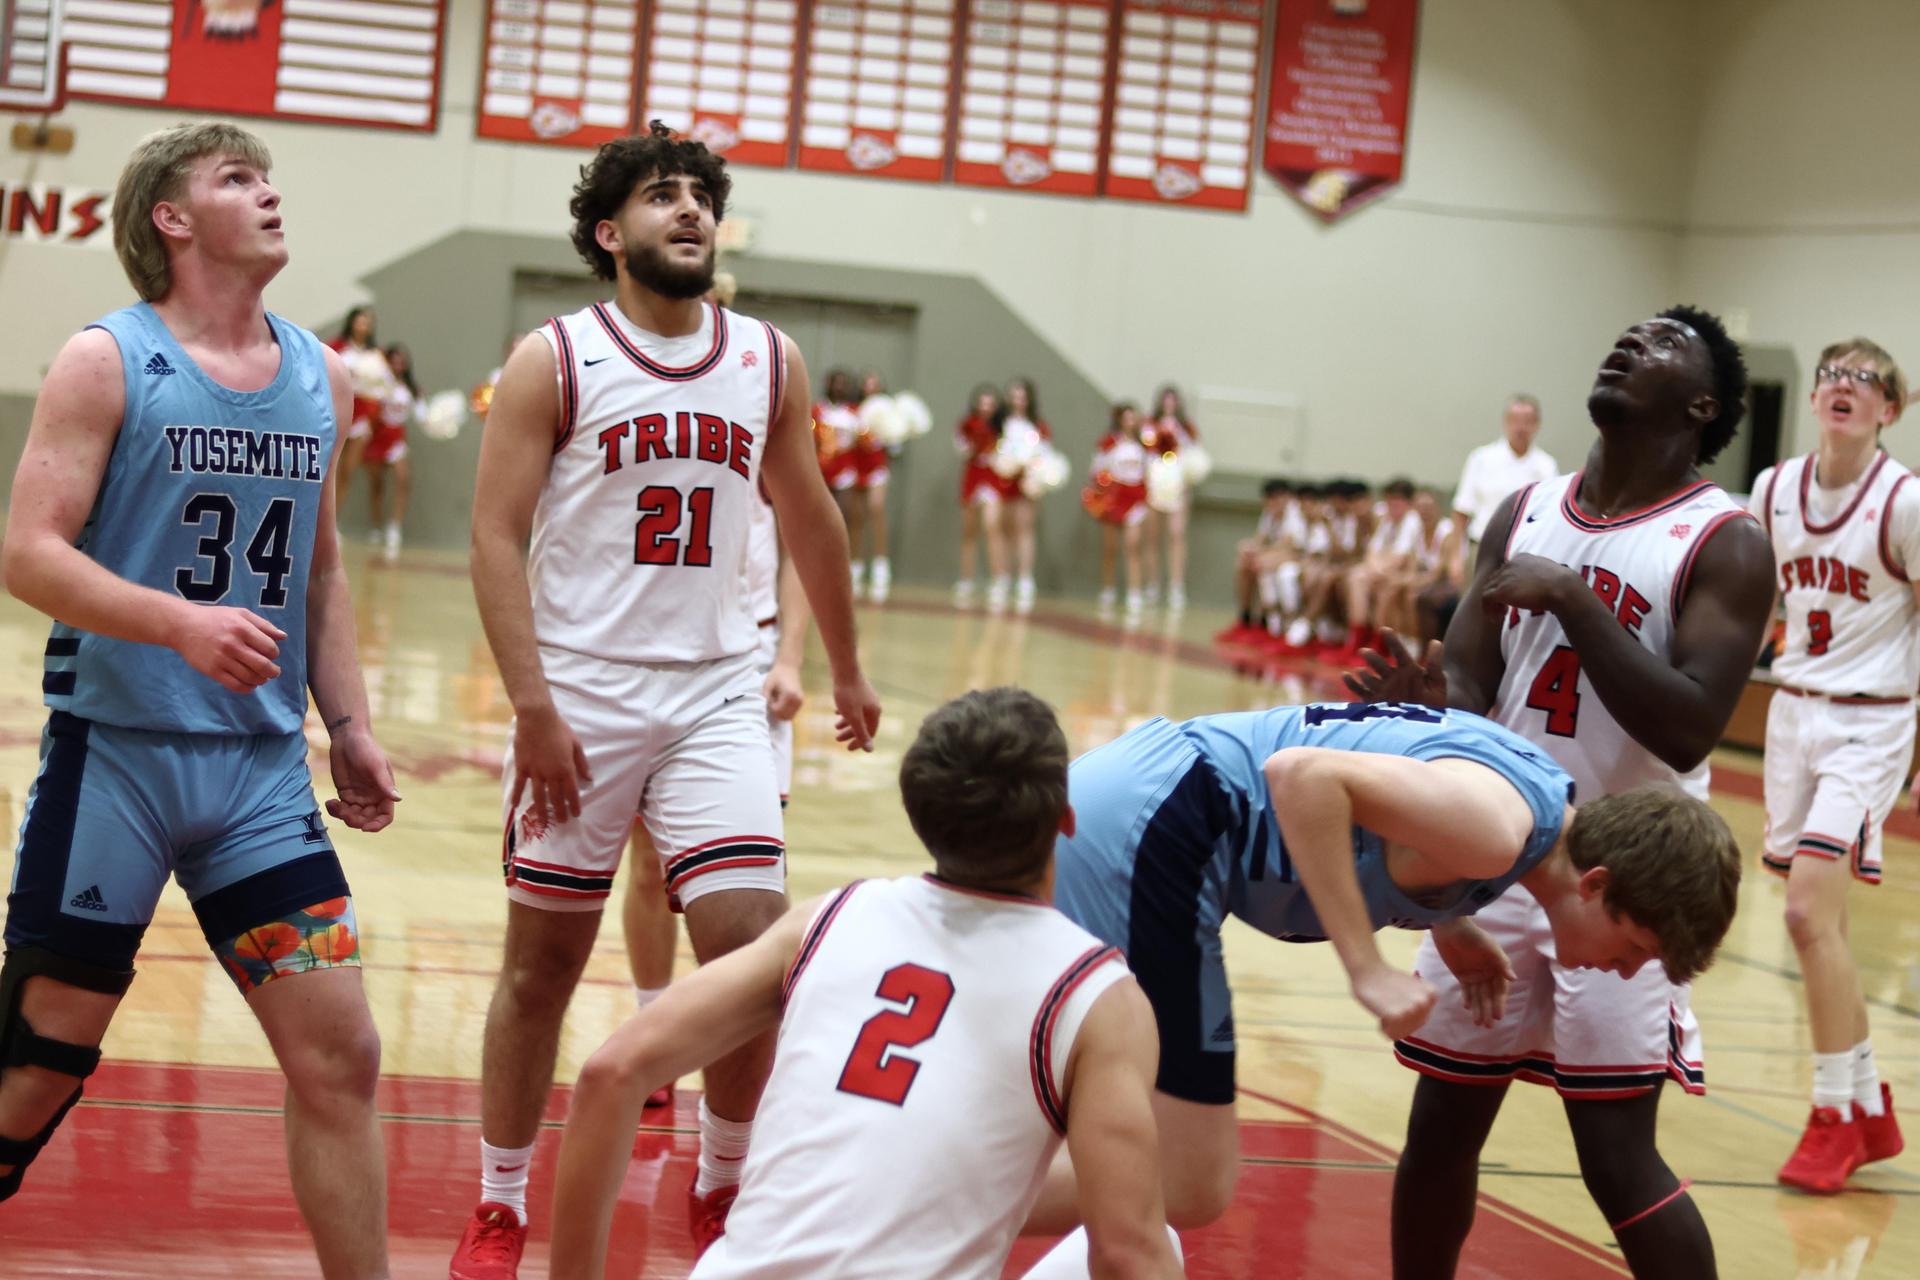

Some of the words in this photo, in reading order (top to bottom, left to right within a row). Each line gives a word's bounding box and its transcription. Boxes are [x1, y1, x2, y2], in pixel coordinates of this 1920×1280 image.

[144, 365, 176, 376] adidas
[164, 426, 322, 483] YOSEMITE
[598, 411, 753, 482] TRIBE
[174, 492, 295, 609] 34
[634, 486, 714, 567] 21
[1526, 644, 1582, 738] 4
[70, 900, 108, 913] adidas
[836, 962, 956, 1108] 2
